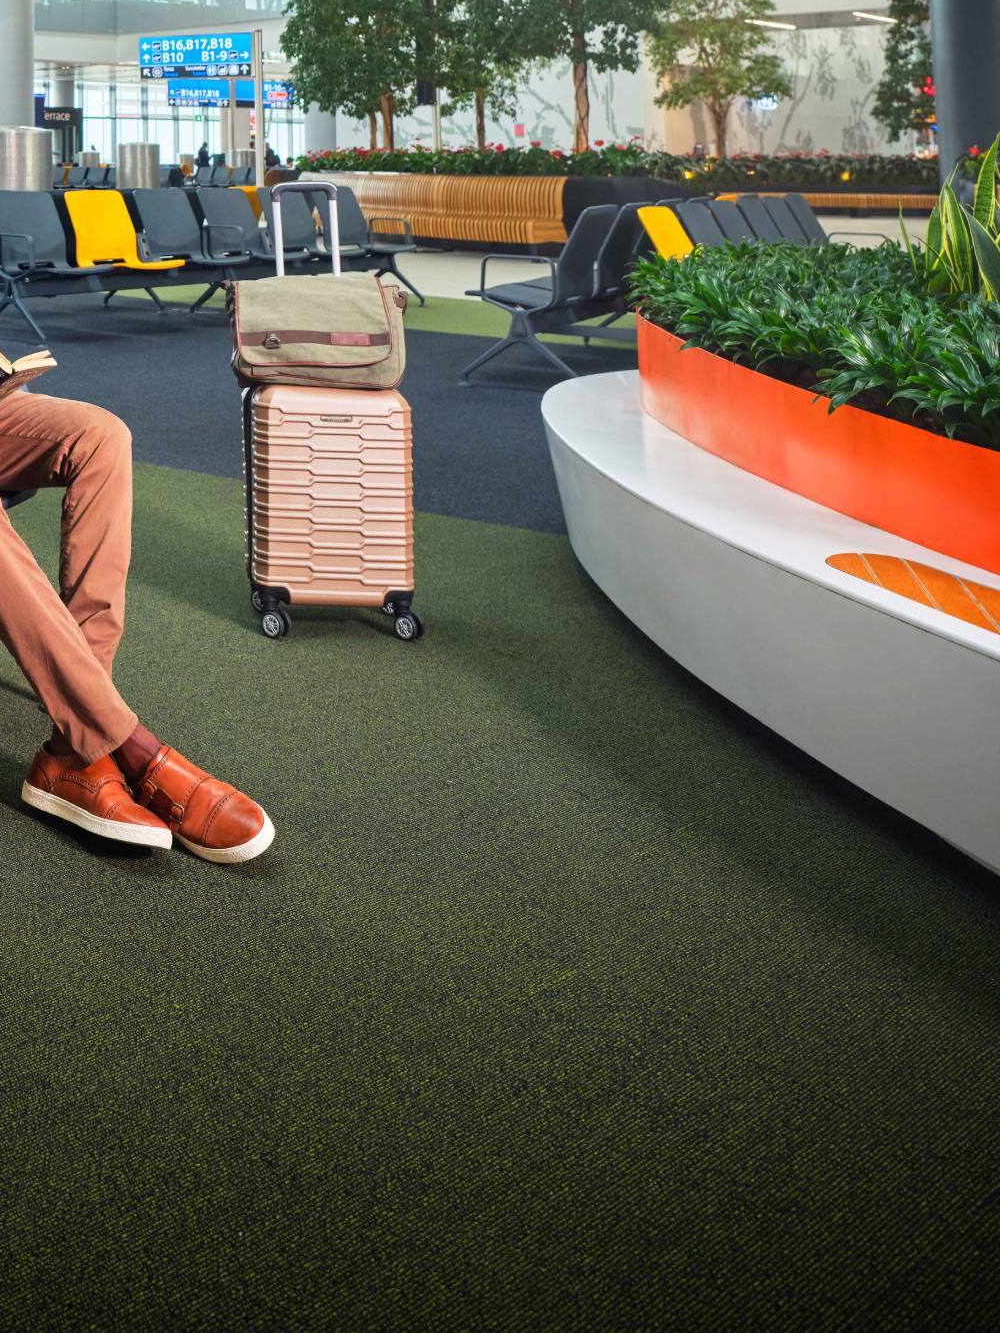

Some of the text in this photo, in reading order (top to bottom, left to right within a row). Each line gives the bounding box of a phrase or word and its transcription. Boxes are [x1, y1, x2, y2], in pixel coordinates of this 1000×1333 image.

[162, 37, 232, 52] B16,B17,B18
[162, 50, 228, 63] B10 B1-9
[43, 110, 71, 121] errace
